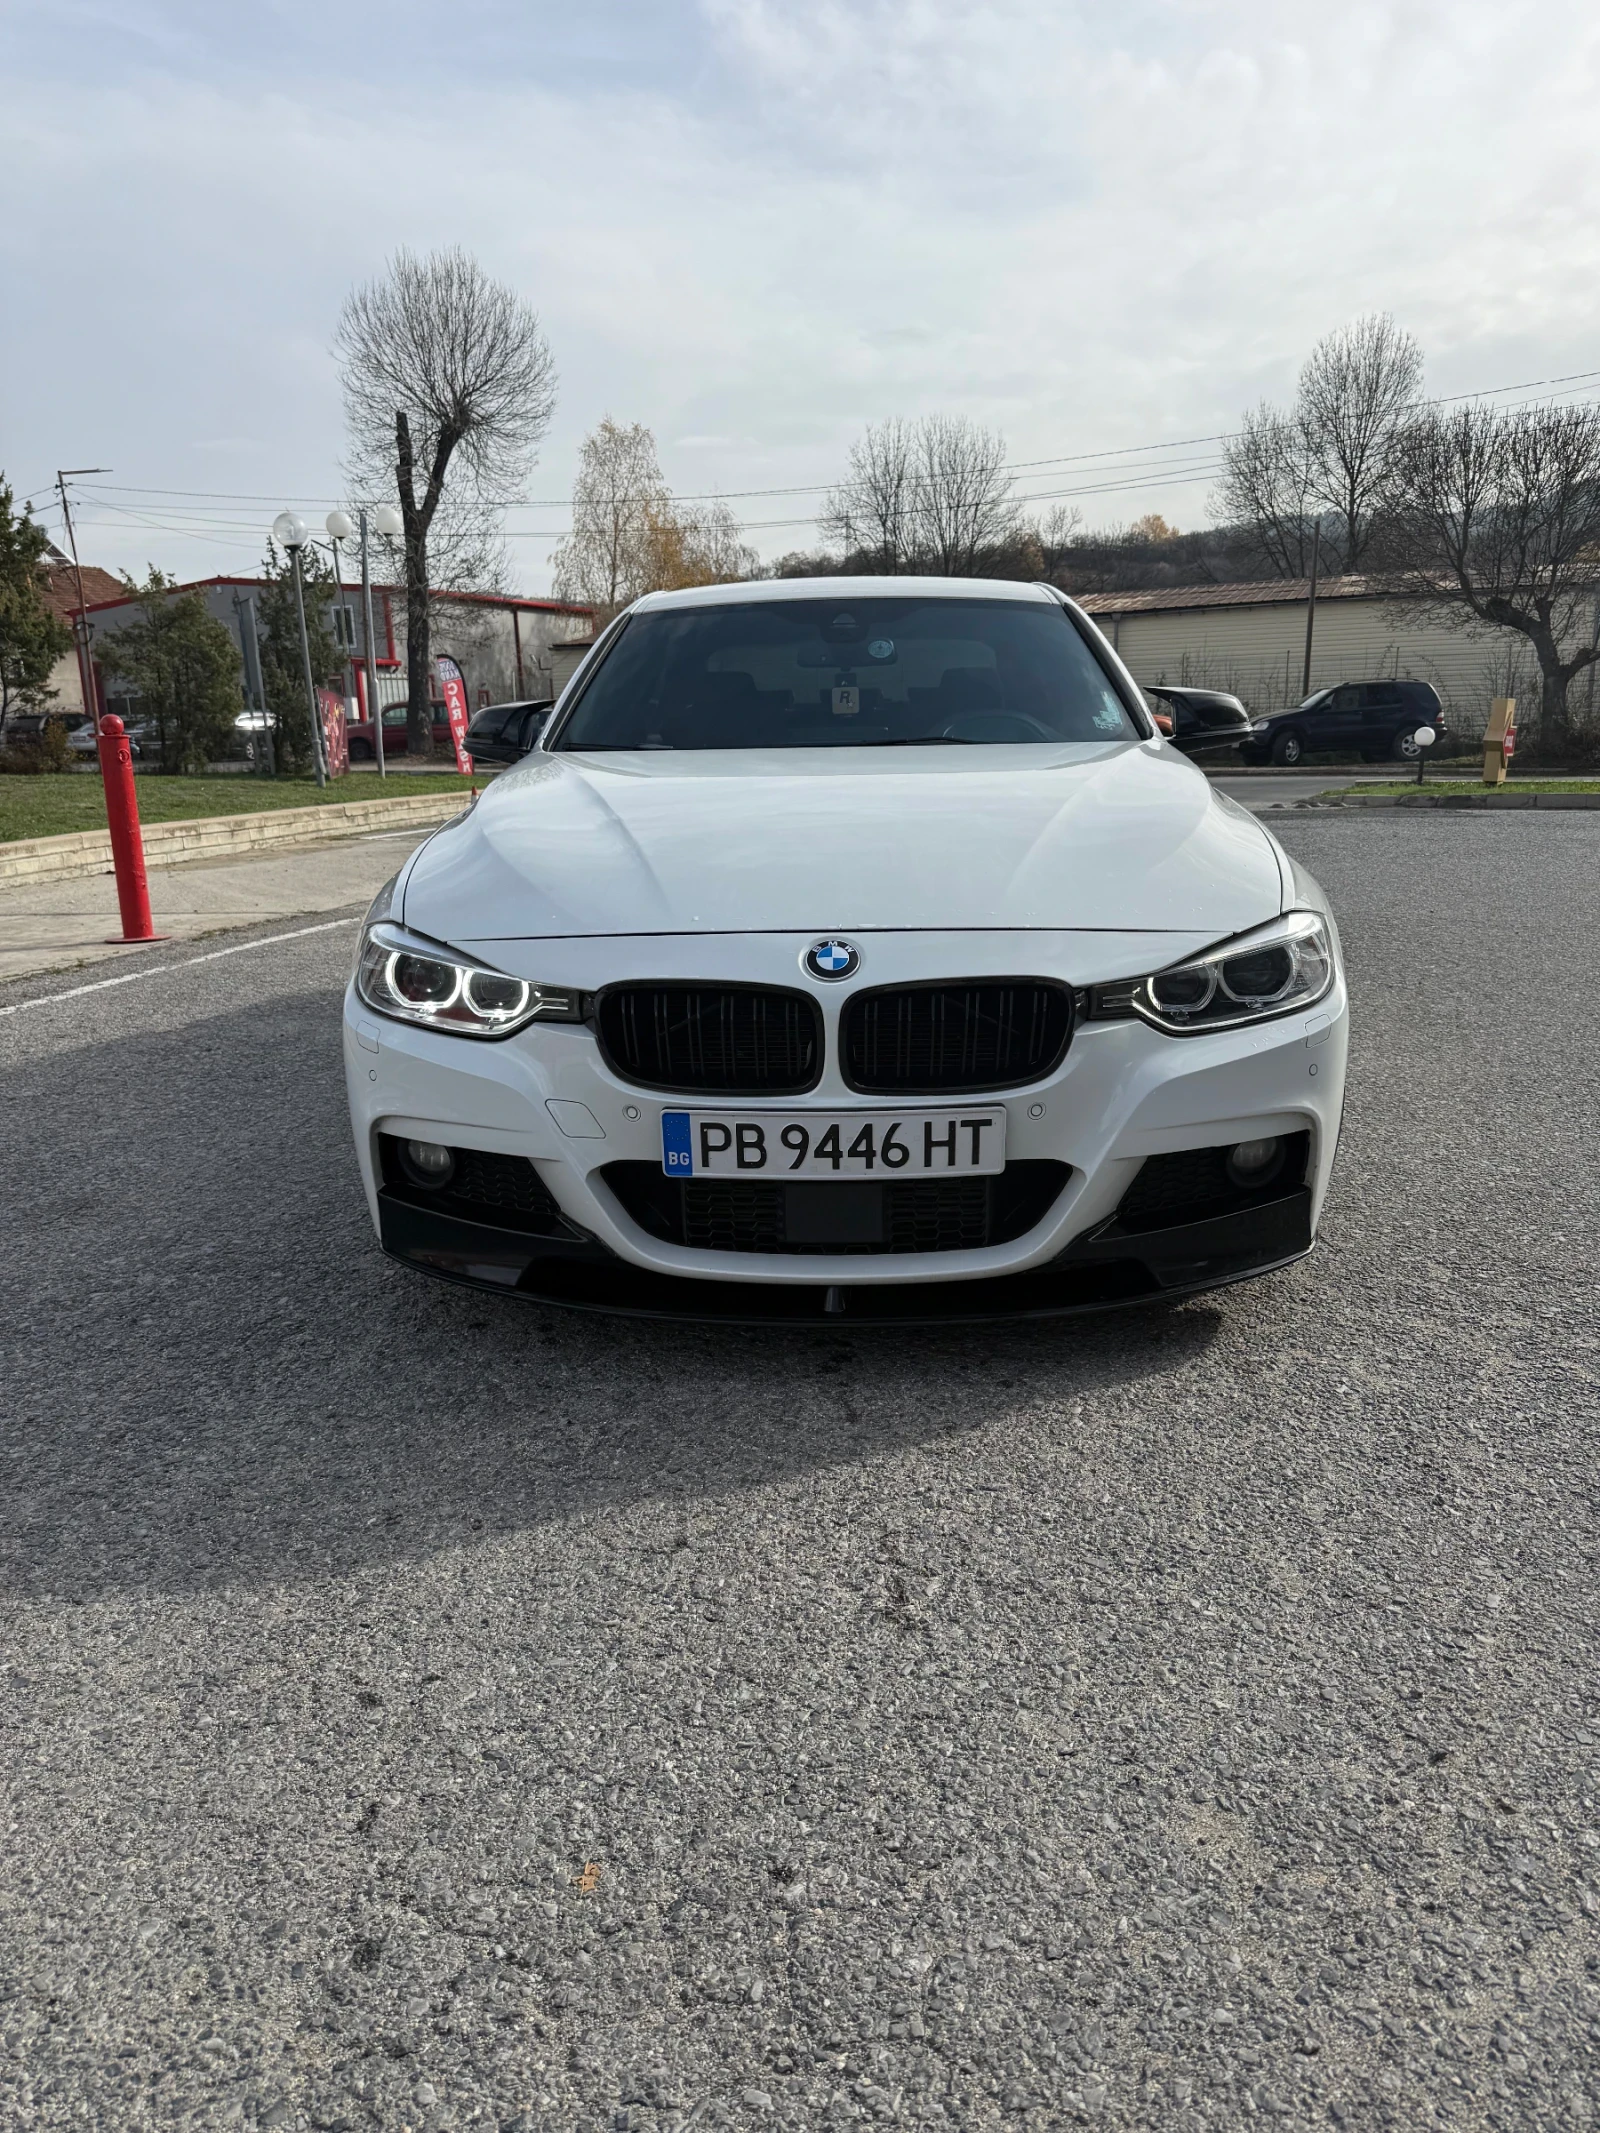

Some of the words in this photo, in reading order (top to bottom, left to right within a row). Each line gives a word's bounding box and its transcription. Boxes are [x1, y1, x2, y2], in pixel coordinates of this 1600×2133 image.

[812, 941, 855, 952] BMW
[700, 1122, 767, 1169] PB
[780, 1122, 910, 1170] 9446
[923, 1119, 993, 1167] HT
[668, 1151, 690, 1166] BG
